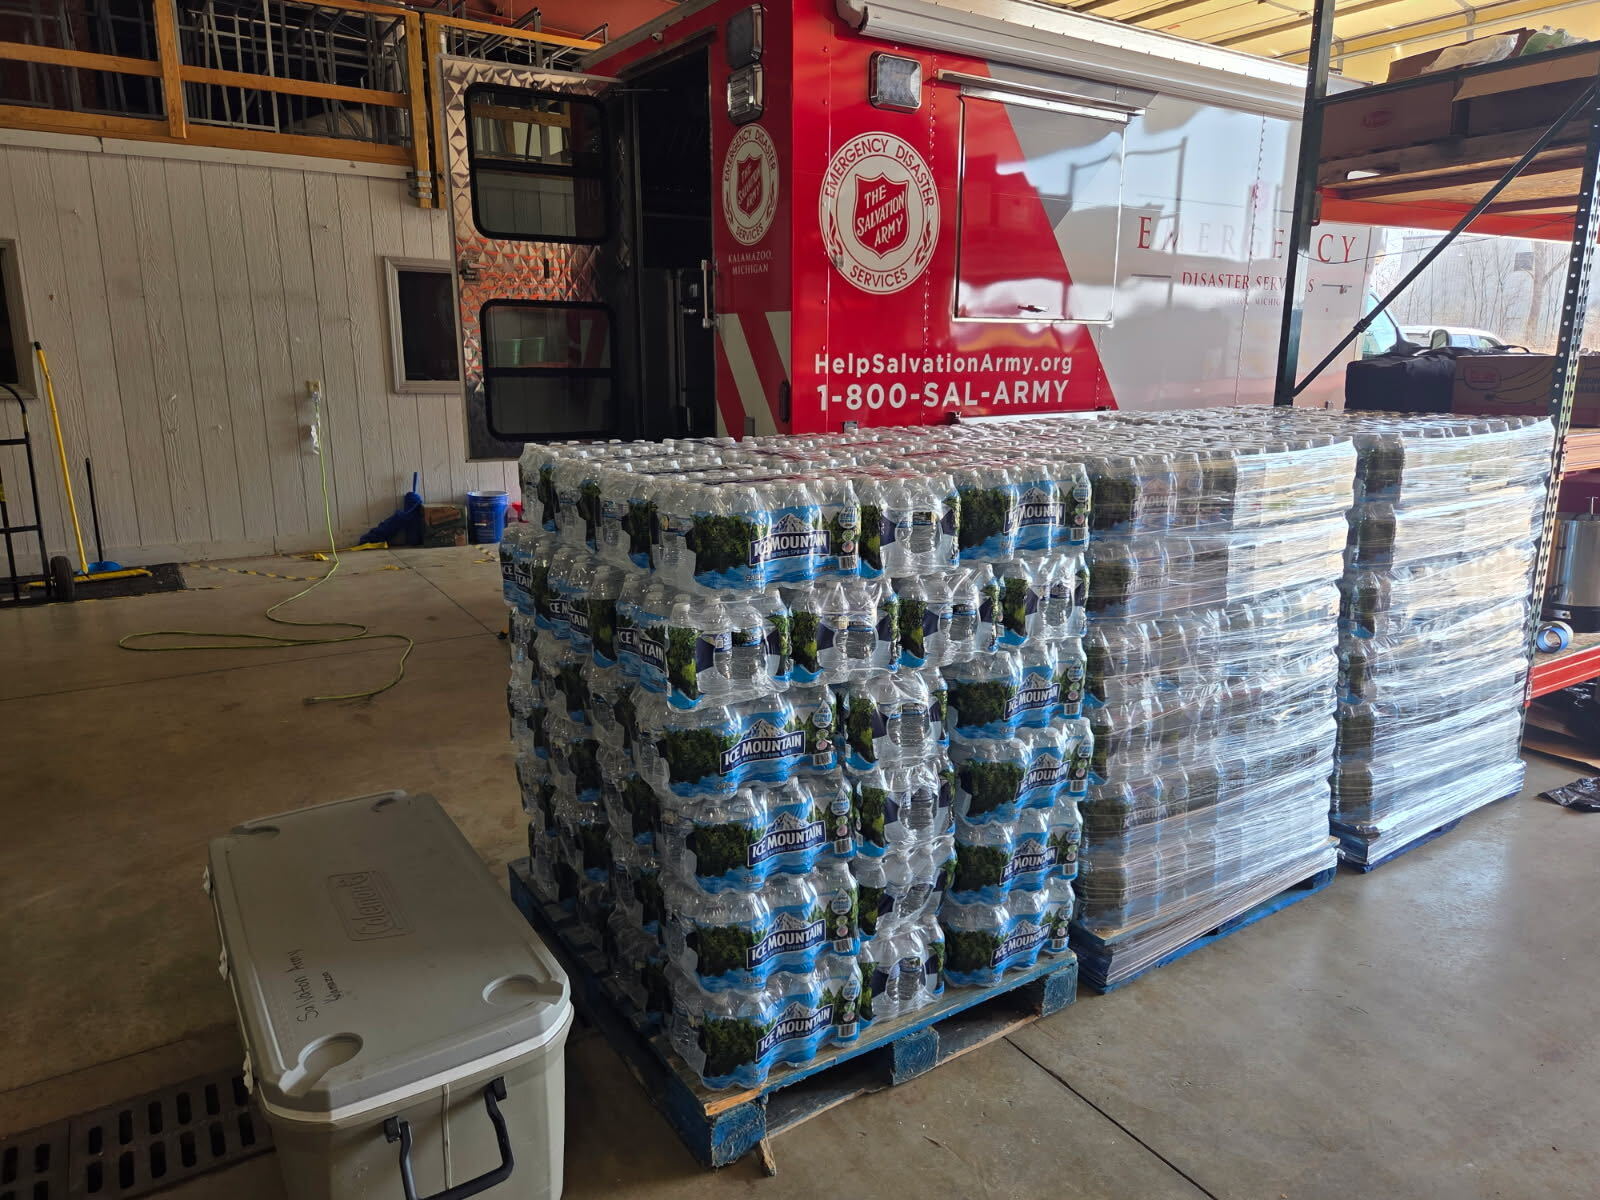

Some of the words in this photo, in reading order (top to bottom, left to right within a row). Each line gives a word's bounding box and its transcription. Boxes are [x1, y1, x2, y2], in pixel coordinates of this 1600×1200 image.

[725, 129, 752, 181] EMERGENCY
[755, 130, 776, 171] DISASTER
[825, 138, 889, 199] EMERGENCY
[895, 145, 935, 207] DISASTER
[864, 184, 887, 209] THE
[857, 191, 905, 237] SALVATION
[736, 223, 764, 241] SERVICES
[874, 214, 904, 248] ARMY
[732, 264, 769, 276] MICHIGAN
[850, 265, 908, 288] SERVICES
[1182, 272, 1250, 290] DISASTER
[815, 353, 1072, 378] HelpSalvationArmy.org
[817, 379, 1069, 411] 1-800-SAL-ARMY
[725, 747, 740, 765] ICE
[742, 734, 802, 756] MOUNTAIN
[752, 843, 767, 858] ICE
[767, 824, 822, 849] MOUNTAIN
[752, 943, 767, 961] ICE
[768, 923, 823, 949] MOUNTAIN
[285, 949, 304, 974] Army
[760, 1033, 775, 1052] ICE
[776, 1007, 830, 1038] MOUNTAIN
